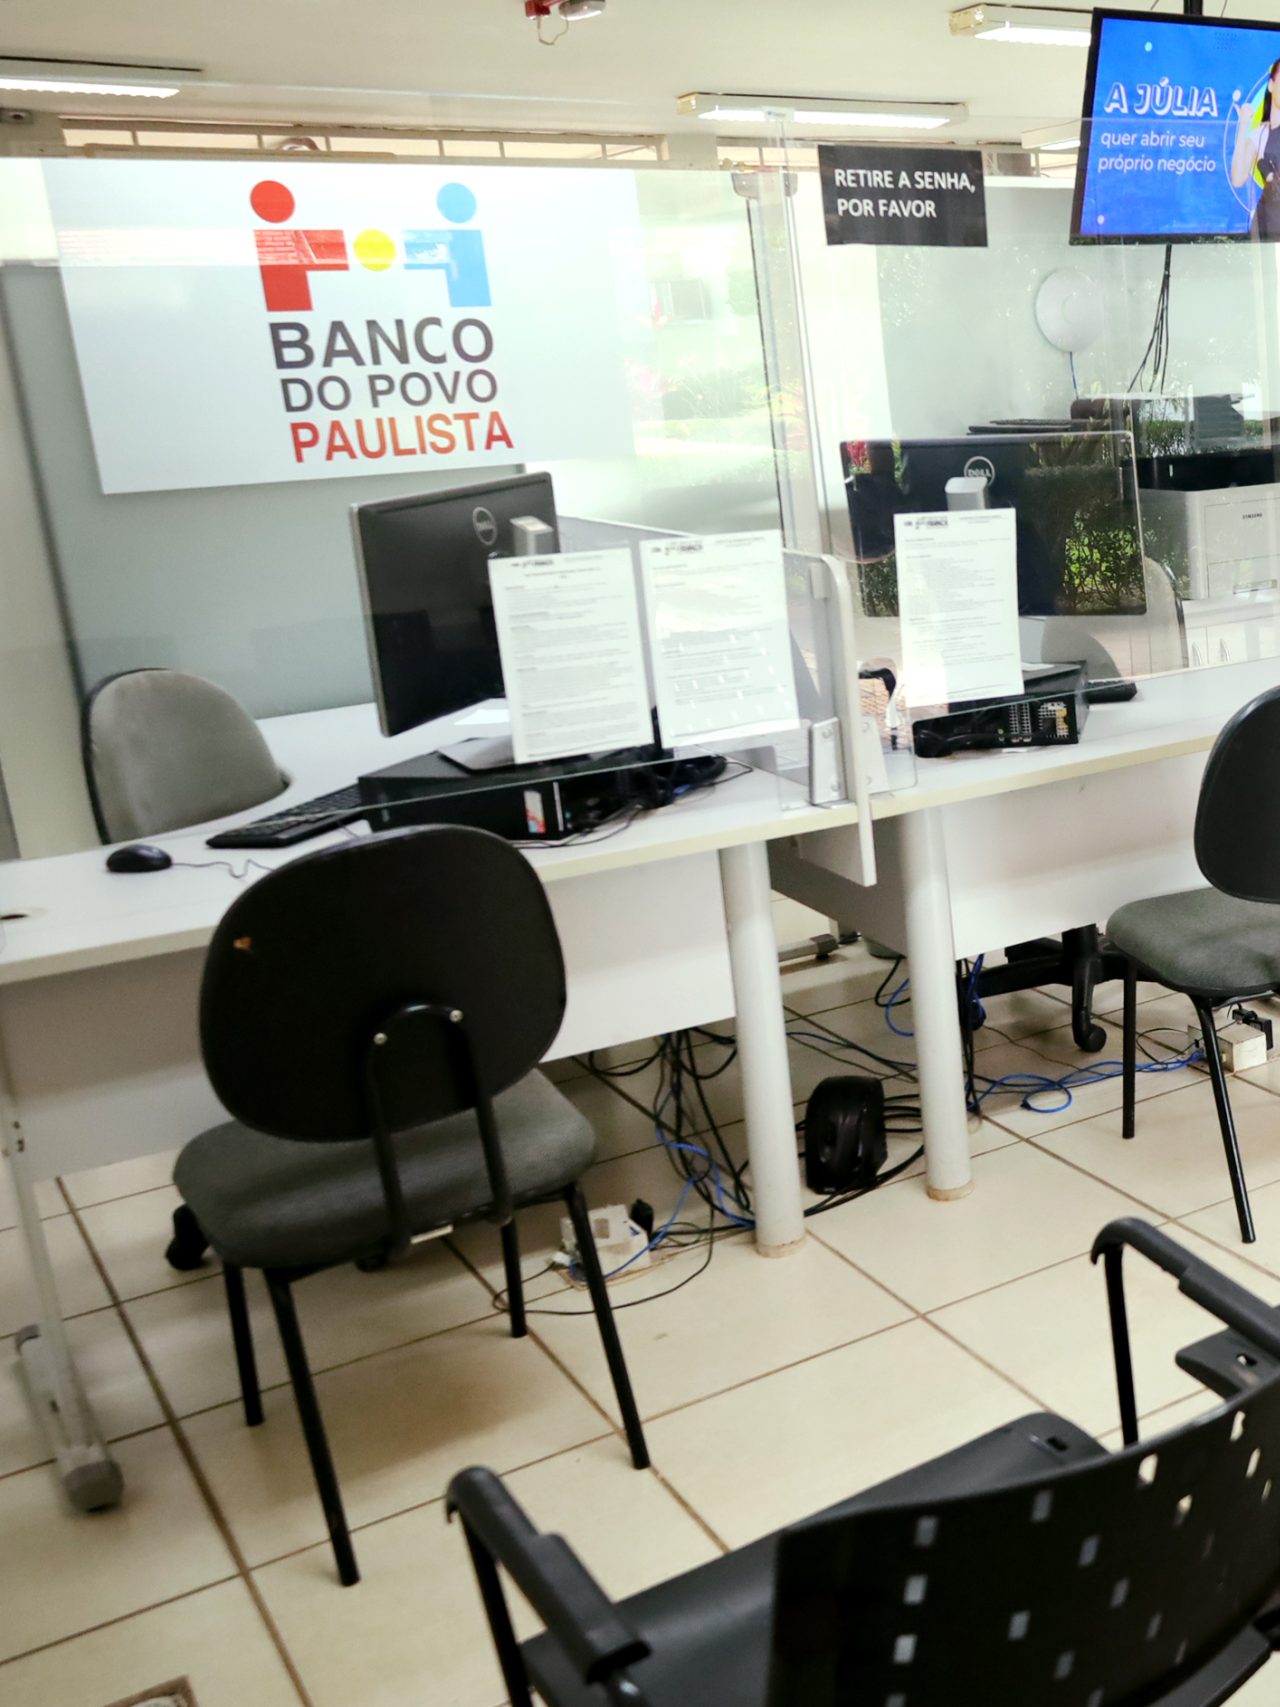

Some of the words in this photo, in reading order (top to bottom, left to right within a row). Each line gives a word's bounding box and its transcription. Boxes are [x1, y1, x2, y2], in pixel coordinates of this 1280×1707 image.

[1103, 81, 1129, 114] A
[1133, 76, 1219, 118] JÚLIA
[1101, 132, 1137, 148] quer
[1140, 129, 1176, 147] abrir
[1179, 135, 1205, 147] seu
[834, 168, 894, 189] RETIRE
[898, 170, 911, 189] A
[914, 170, 976, 194] SENHA,
[1097, 155, 1154, 175] próprio
[1157, 156, 1216, 175] negócio
[837, 198, 875, 217] POR
[878, 199, 937, 218] FAVOR
[269, 317, 494, 369] BANCO
[280, 375, 352, 412] DO
[367, 369, 498, 408] POVO
[290, 411, 514, 463] PAULISTA
